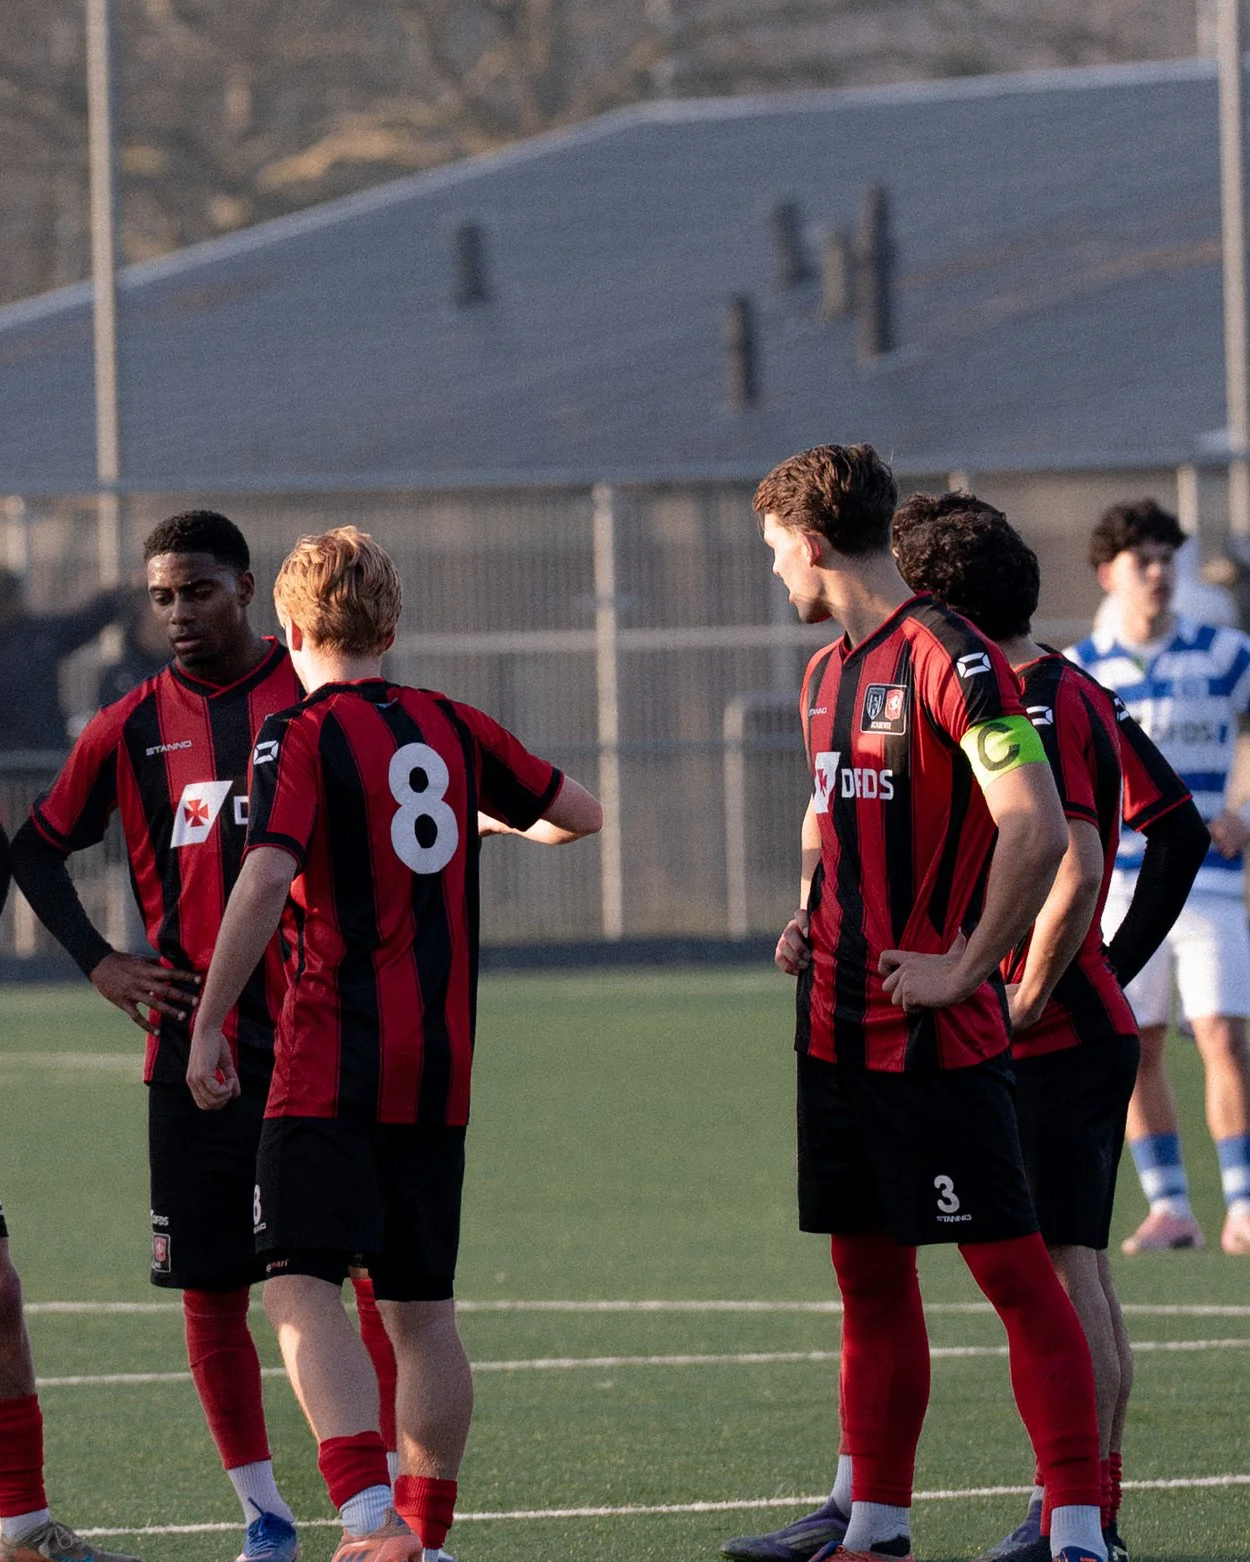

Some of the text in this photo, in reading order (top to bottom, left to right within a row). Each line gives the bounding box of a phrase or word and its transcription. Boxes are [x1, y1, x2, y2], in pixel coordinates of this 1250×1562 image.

[146, 740, 192, 756] STANNO
[977, 722, 1022, 772] C
[841, 768, 894, 800] DFDS
[388, 742, 459, 875] 8
[934, 1175, 960, 1214] 3
